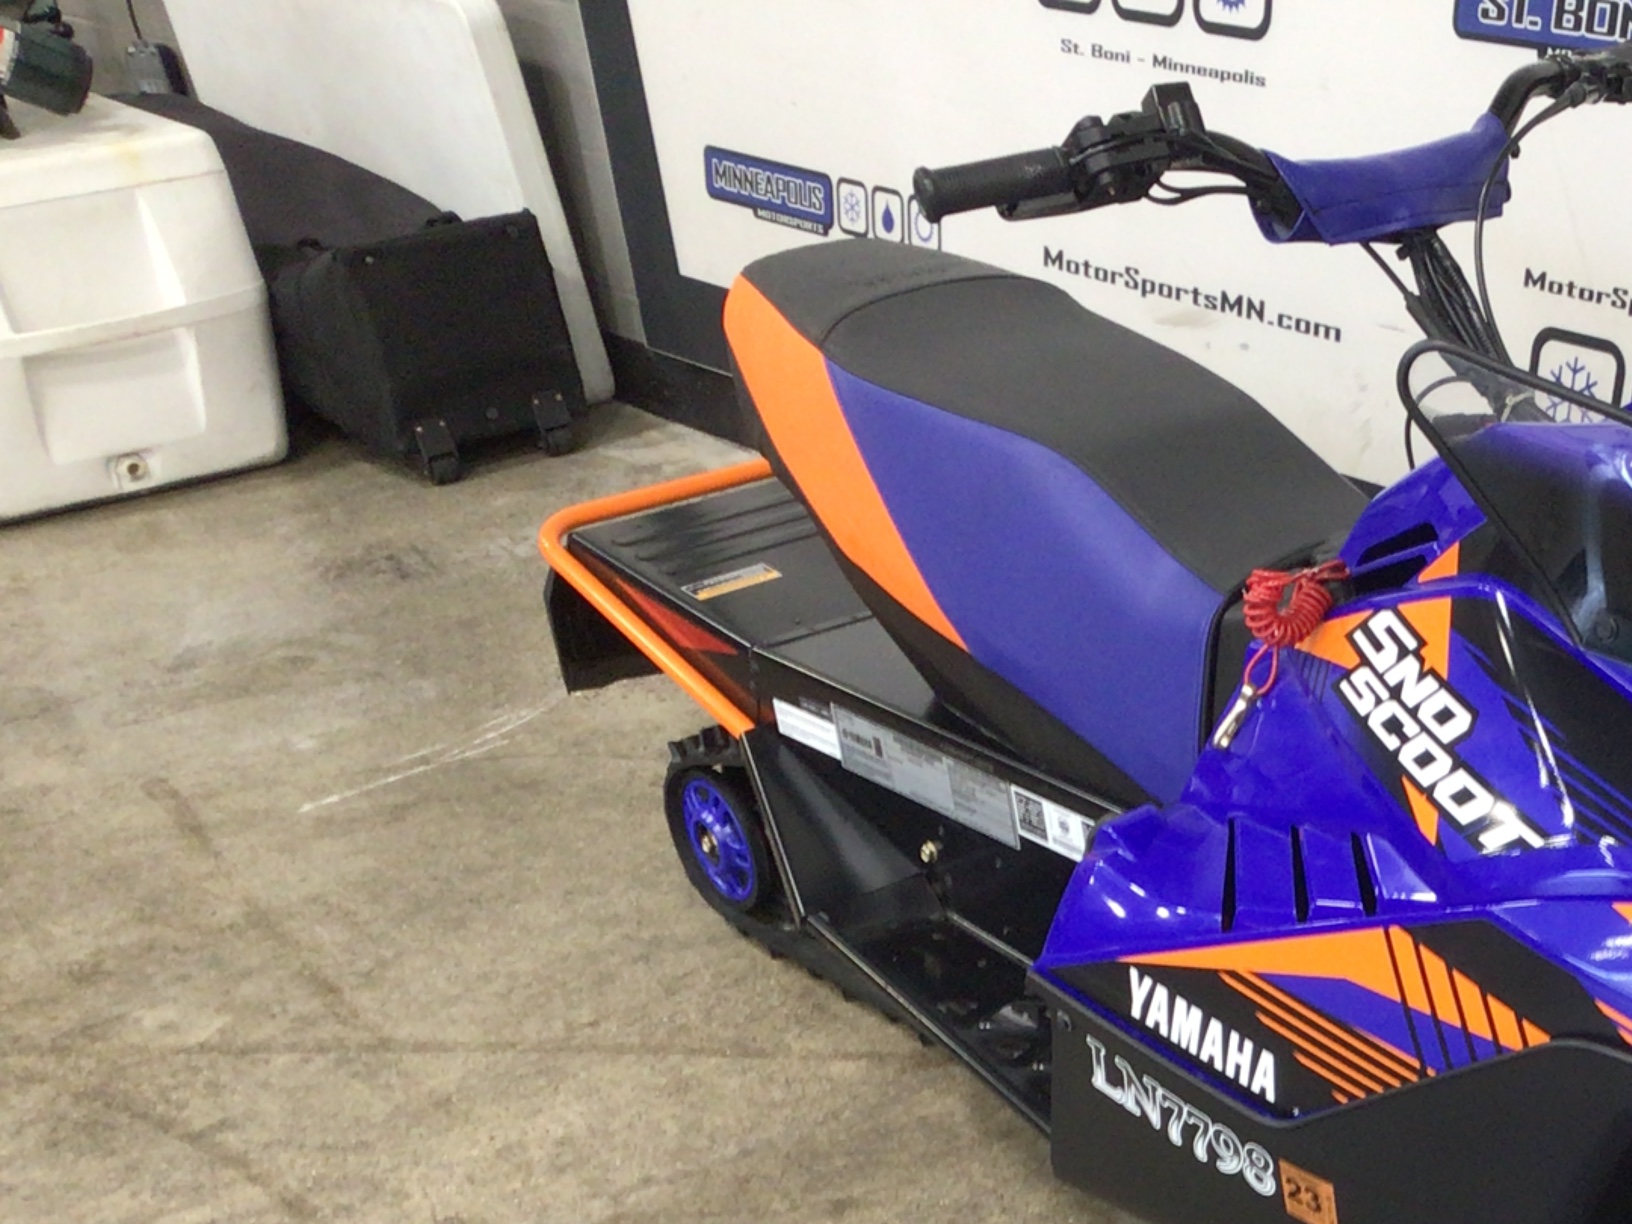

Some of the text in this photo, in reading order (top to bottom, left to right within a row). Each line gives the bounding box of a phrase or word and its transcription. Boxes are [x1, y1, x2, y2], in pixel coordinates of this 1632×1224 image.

[1060, 38, 1085, 57] St.
[1091, 43, 1131, 64] Boni
[1152, 54, 1266, 87] Minneapolis
[711, 158, 825, 214] MINNEAPOLIS
[1043, 245, 1341, 342] MotorSportsMN.com
[1352, 609, 1473, 744] SNO
[1339, 666, 1546, 851] SCOOT
[1129, 965, 1276, 1104] YAMAHA
[1086, 1034, 1276, 1197] LN7798
[1284, 1176, 1323, 1214] 23
